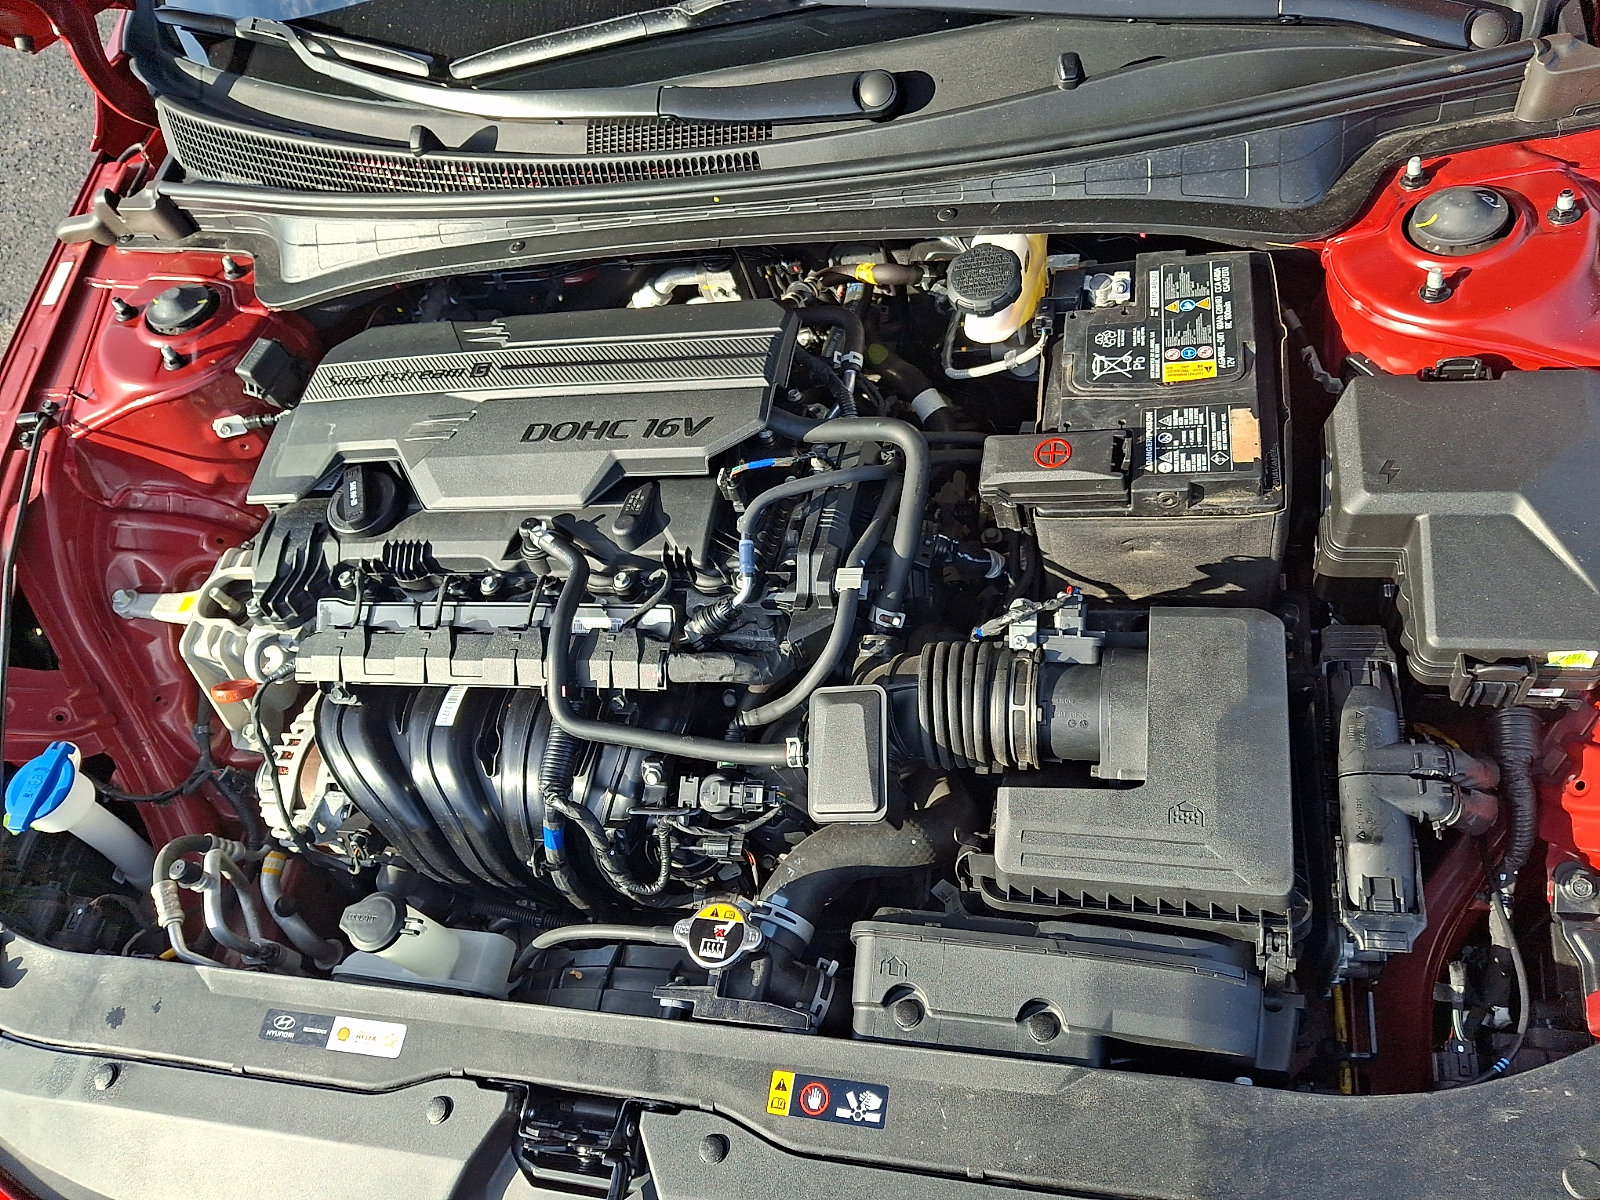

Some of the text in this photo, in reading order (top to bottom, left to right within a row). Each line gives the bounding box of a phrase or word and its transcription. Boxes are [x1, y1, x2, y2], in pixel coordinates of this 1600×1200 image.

[1214, 282, 1222, 293] CCA
[1132, 356, 1146, 371] Pb
[1227, 356, 1236, 368] 12V
[325, 367, 466, 388] Smartstream
[520, 416, 715, 442] DOHC 16V
[1145, 411, 1153, 465] DANGER/POISON
[347, 913, 378, 922] COOLANT
[266, 1030, 295, 1039] HYUNDAI
